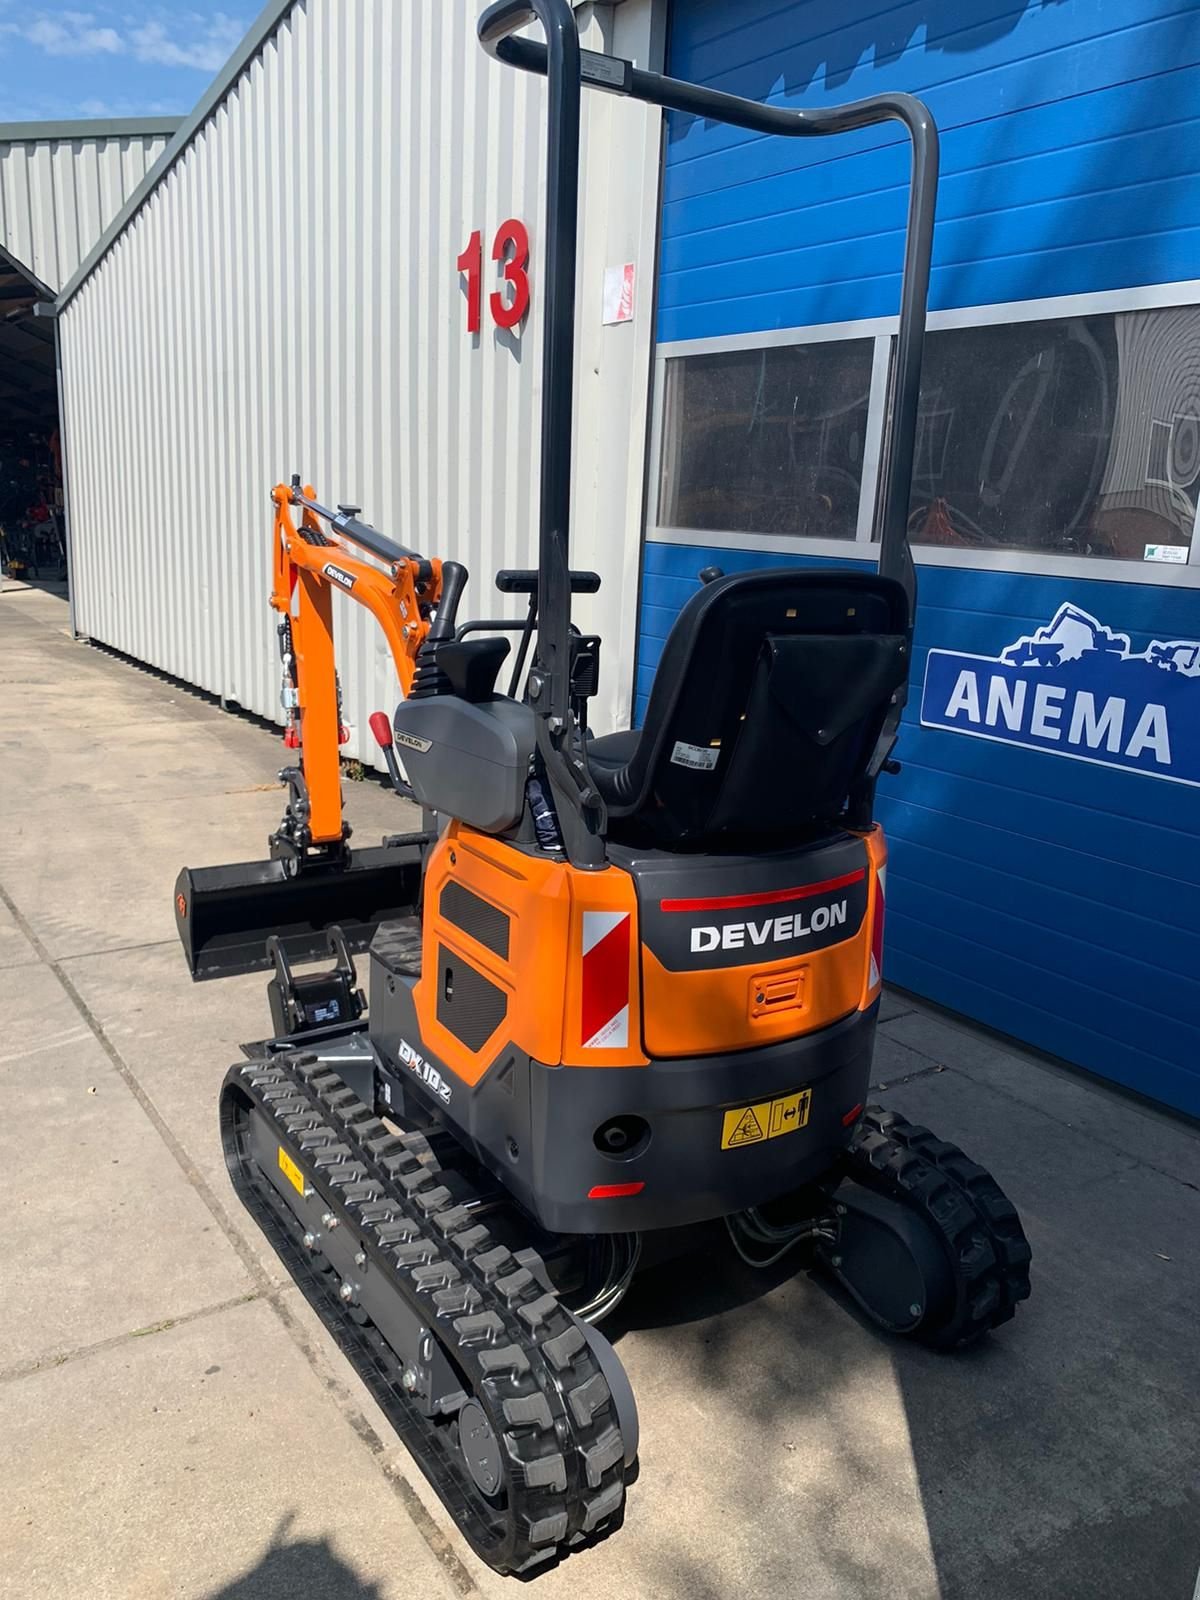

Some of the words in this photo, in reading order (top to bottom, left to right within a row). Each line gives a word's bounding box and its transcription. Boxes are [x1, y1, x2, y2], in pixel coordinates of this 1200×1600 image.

[457, 219, 529, 332] 13
[326, 565, 354, 588] DEVELON
[944, 670, 1171, 765] ANEMA
[691, 900, 847, 952] DEVELON
